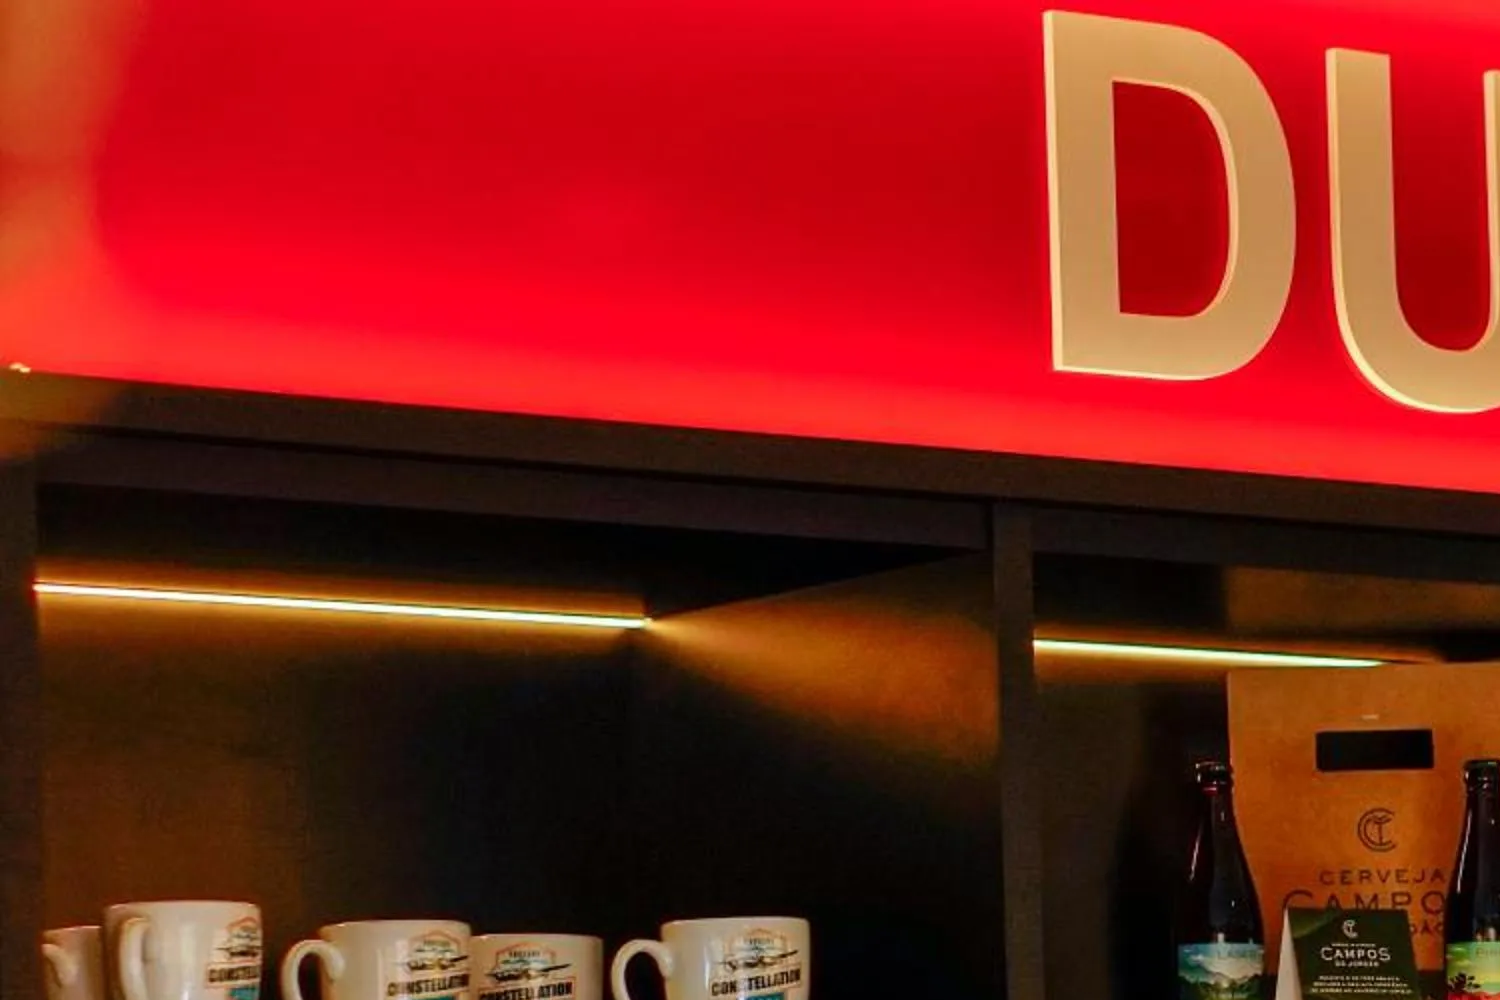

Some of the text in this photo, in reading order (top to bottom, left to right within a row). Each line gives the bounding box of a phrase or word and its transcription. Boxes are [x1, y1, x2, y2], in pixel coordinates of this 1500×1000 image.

[1319, 868, 1446, 886] CERVEJA
[1282, 889, 1448, 915] CAMPO
[1320, 946, 1392, 962] CAMPOS
[711, 968, 801, 997] CONTELLATION
